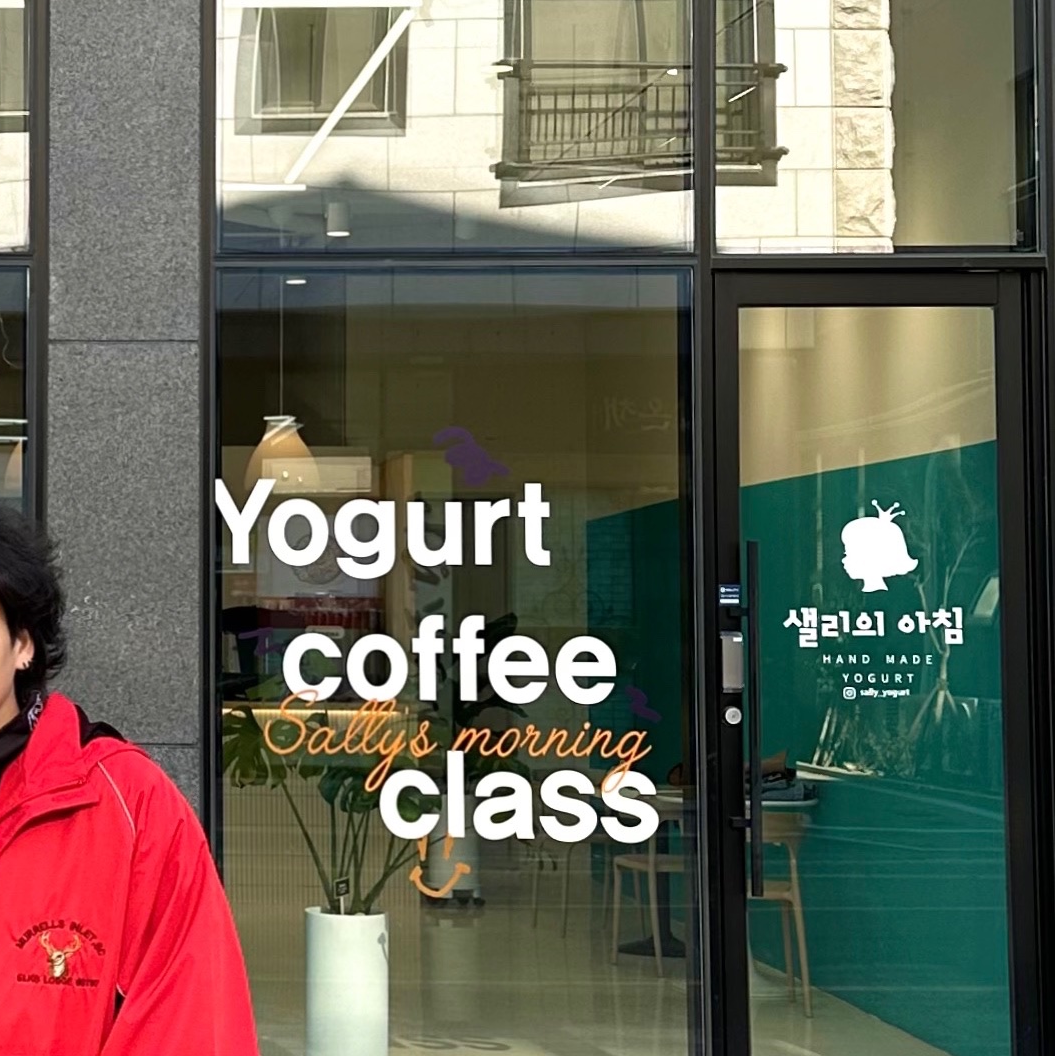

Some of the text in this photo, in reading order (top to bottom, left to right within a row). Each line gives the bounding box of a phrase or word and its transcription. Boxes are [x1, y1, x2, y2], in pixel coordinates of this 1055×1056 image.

[215, 478, 551, 580] Yogurt
[282, 614, 617, 705] coffee
[783, 606, 964, 648] 샐리의 아침
[822, 654, 934, 665] HAND MADE
[842, 673, 915, 684] YOGURT
[450, 721, 653, 795] morning
[379, 750, 659, 844] class
